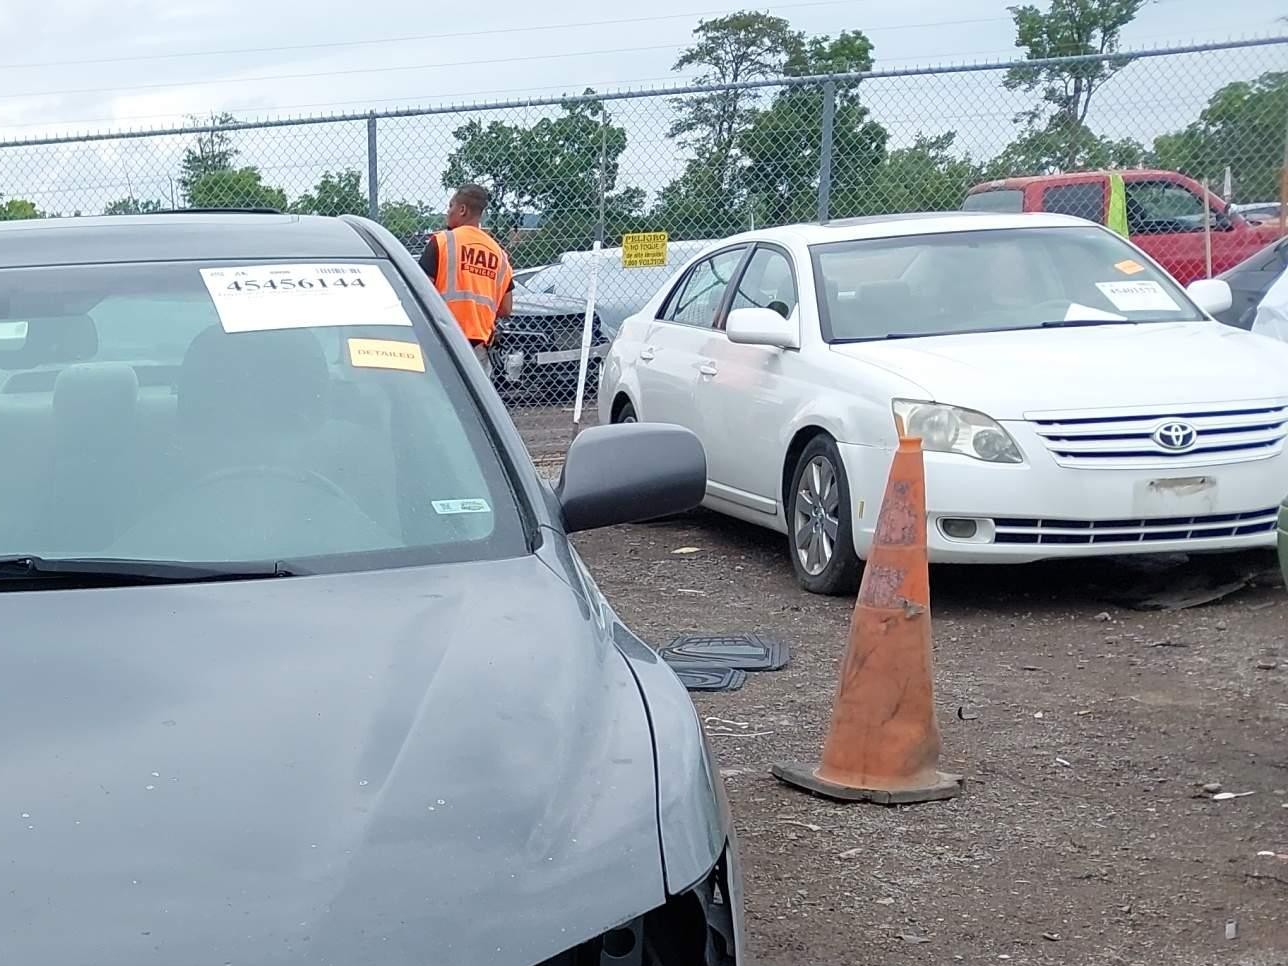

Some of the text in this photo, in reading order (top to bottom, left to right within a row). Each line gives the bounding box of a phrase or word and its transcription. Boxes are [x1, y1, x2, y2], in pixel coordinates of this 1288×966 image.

[625, 234, 666, 244] PELIGRO
[461, 245, 498, 270] MAD
[227, 277, 366, 292] 45456144
[357, 349, 415, 359] DETAILED
